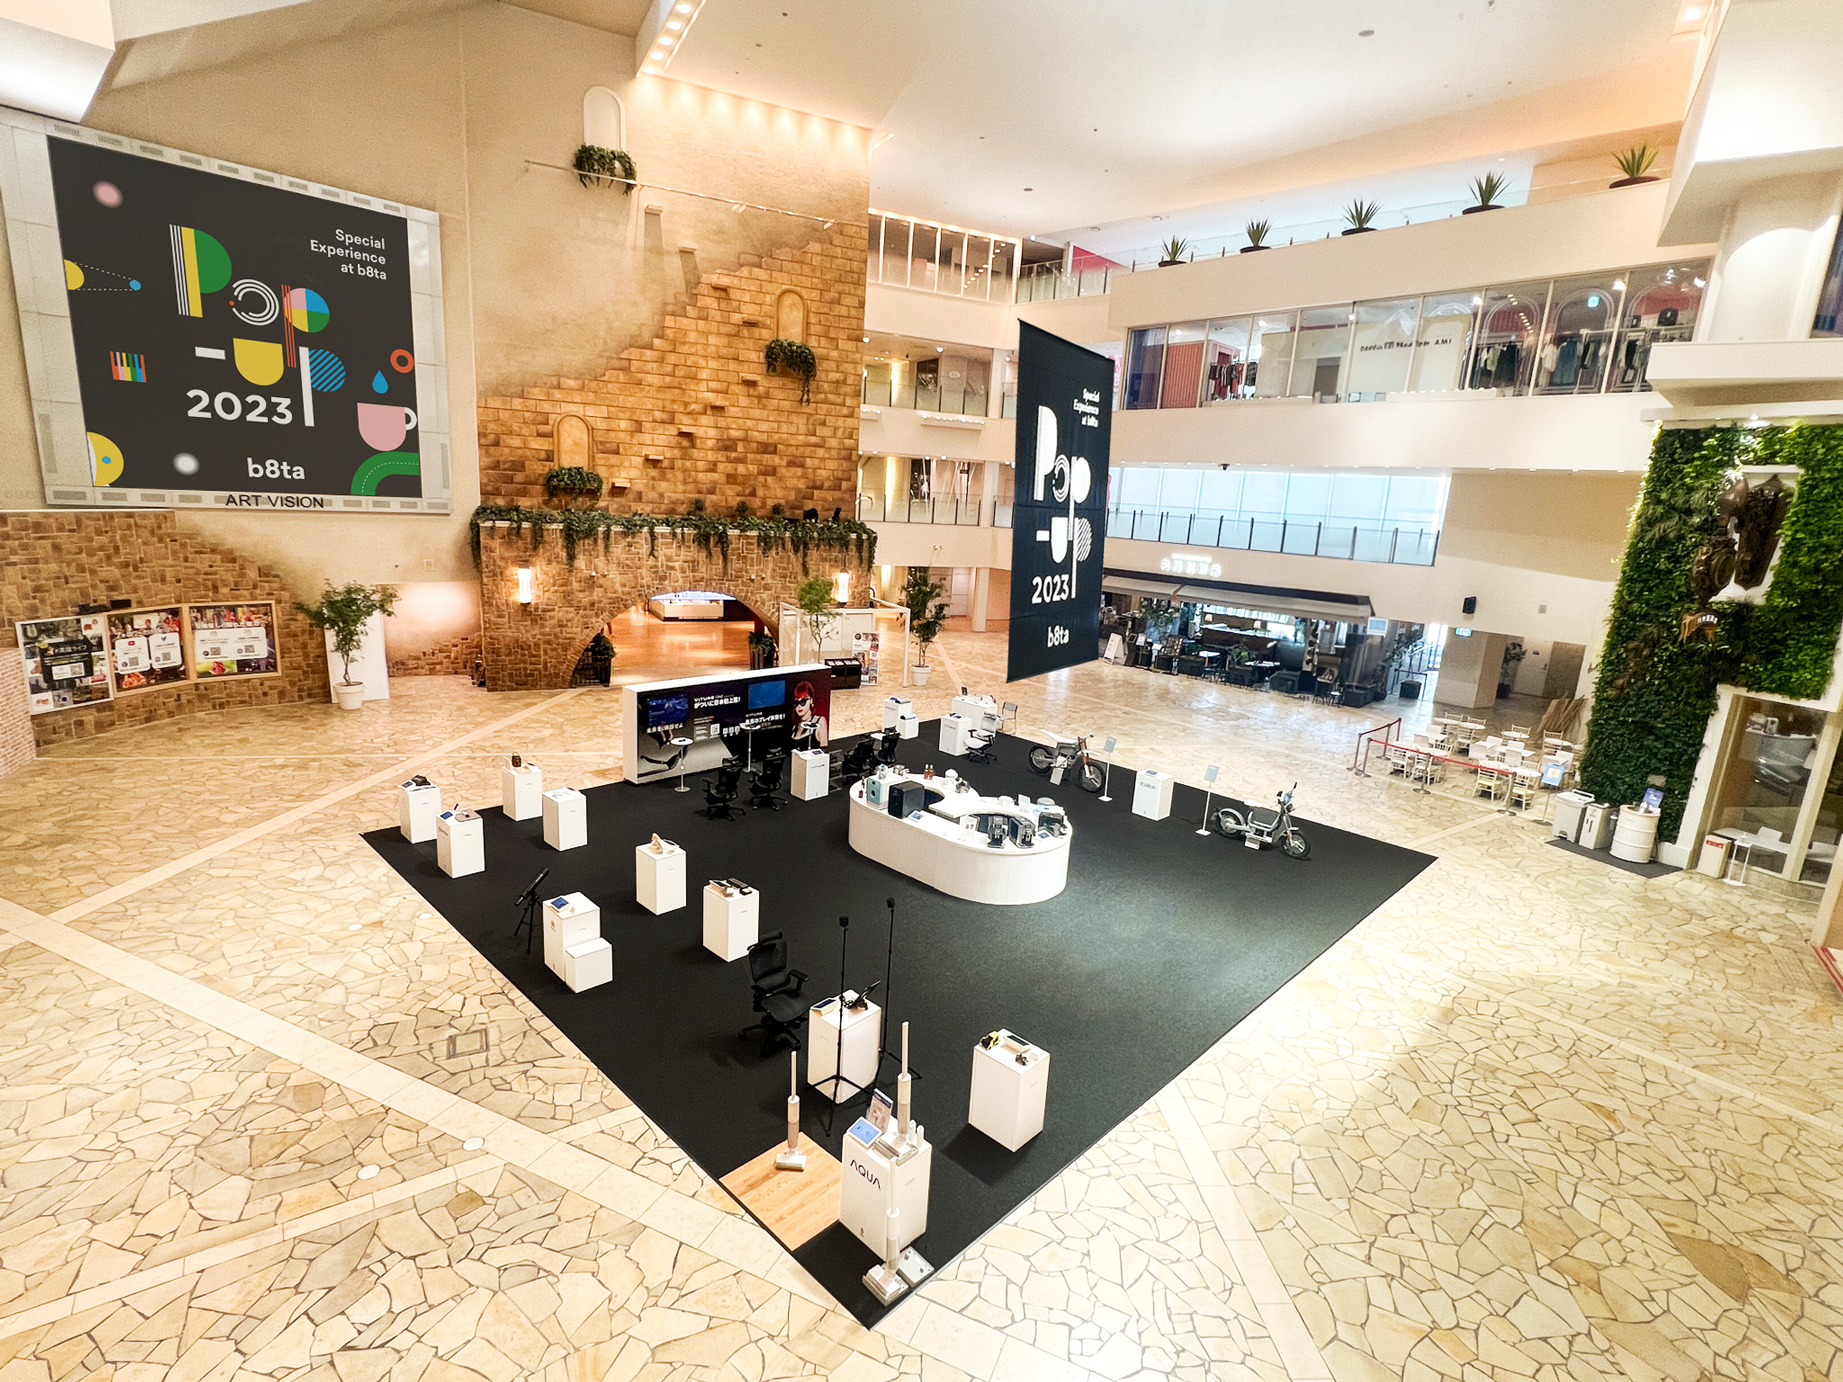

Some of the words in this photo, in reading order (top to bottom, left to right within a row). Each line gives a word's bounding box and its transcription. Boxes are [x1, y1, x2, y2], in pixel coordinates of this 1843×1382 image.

[335, 228, 385, 250] Special
[310, 239, 386, 265] Experience
[340, 263, 354, 275] at
[357, 263, 387, 280] b8ta
[1083, 387, 1100, 403] Special
[186, 388, 293, 425] 2023
[1073, 398, 1099, 415] Experience
[1081, 415, 1087, 426] at
[1087, 414, 1099, 428] b8ta
[246, 457, 306, 480] b8ta
[225, 493, 262, 507] ART
[267, 495, 325, 509] VISION
[1031, 573, 1070, 605] 2023
[1047, 624, 1070, 648] b8ta
[850, 1159, 881, 1191] AQUA
